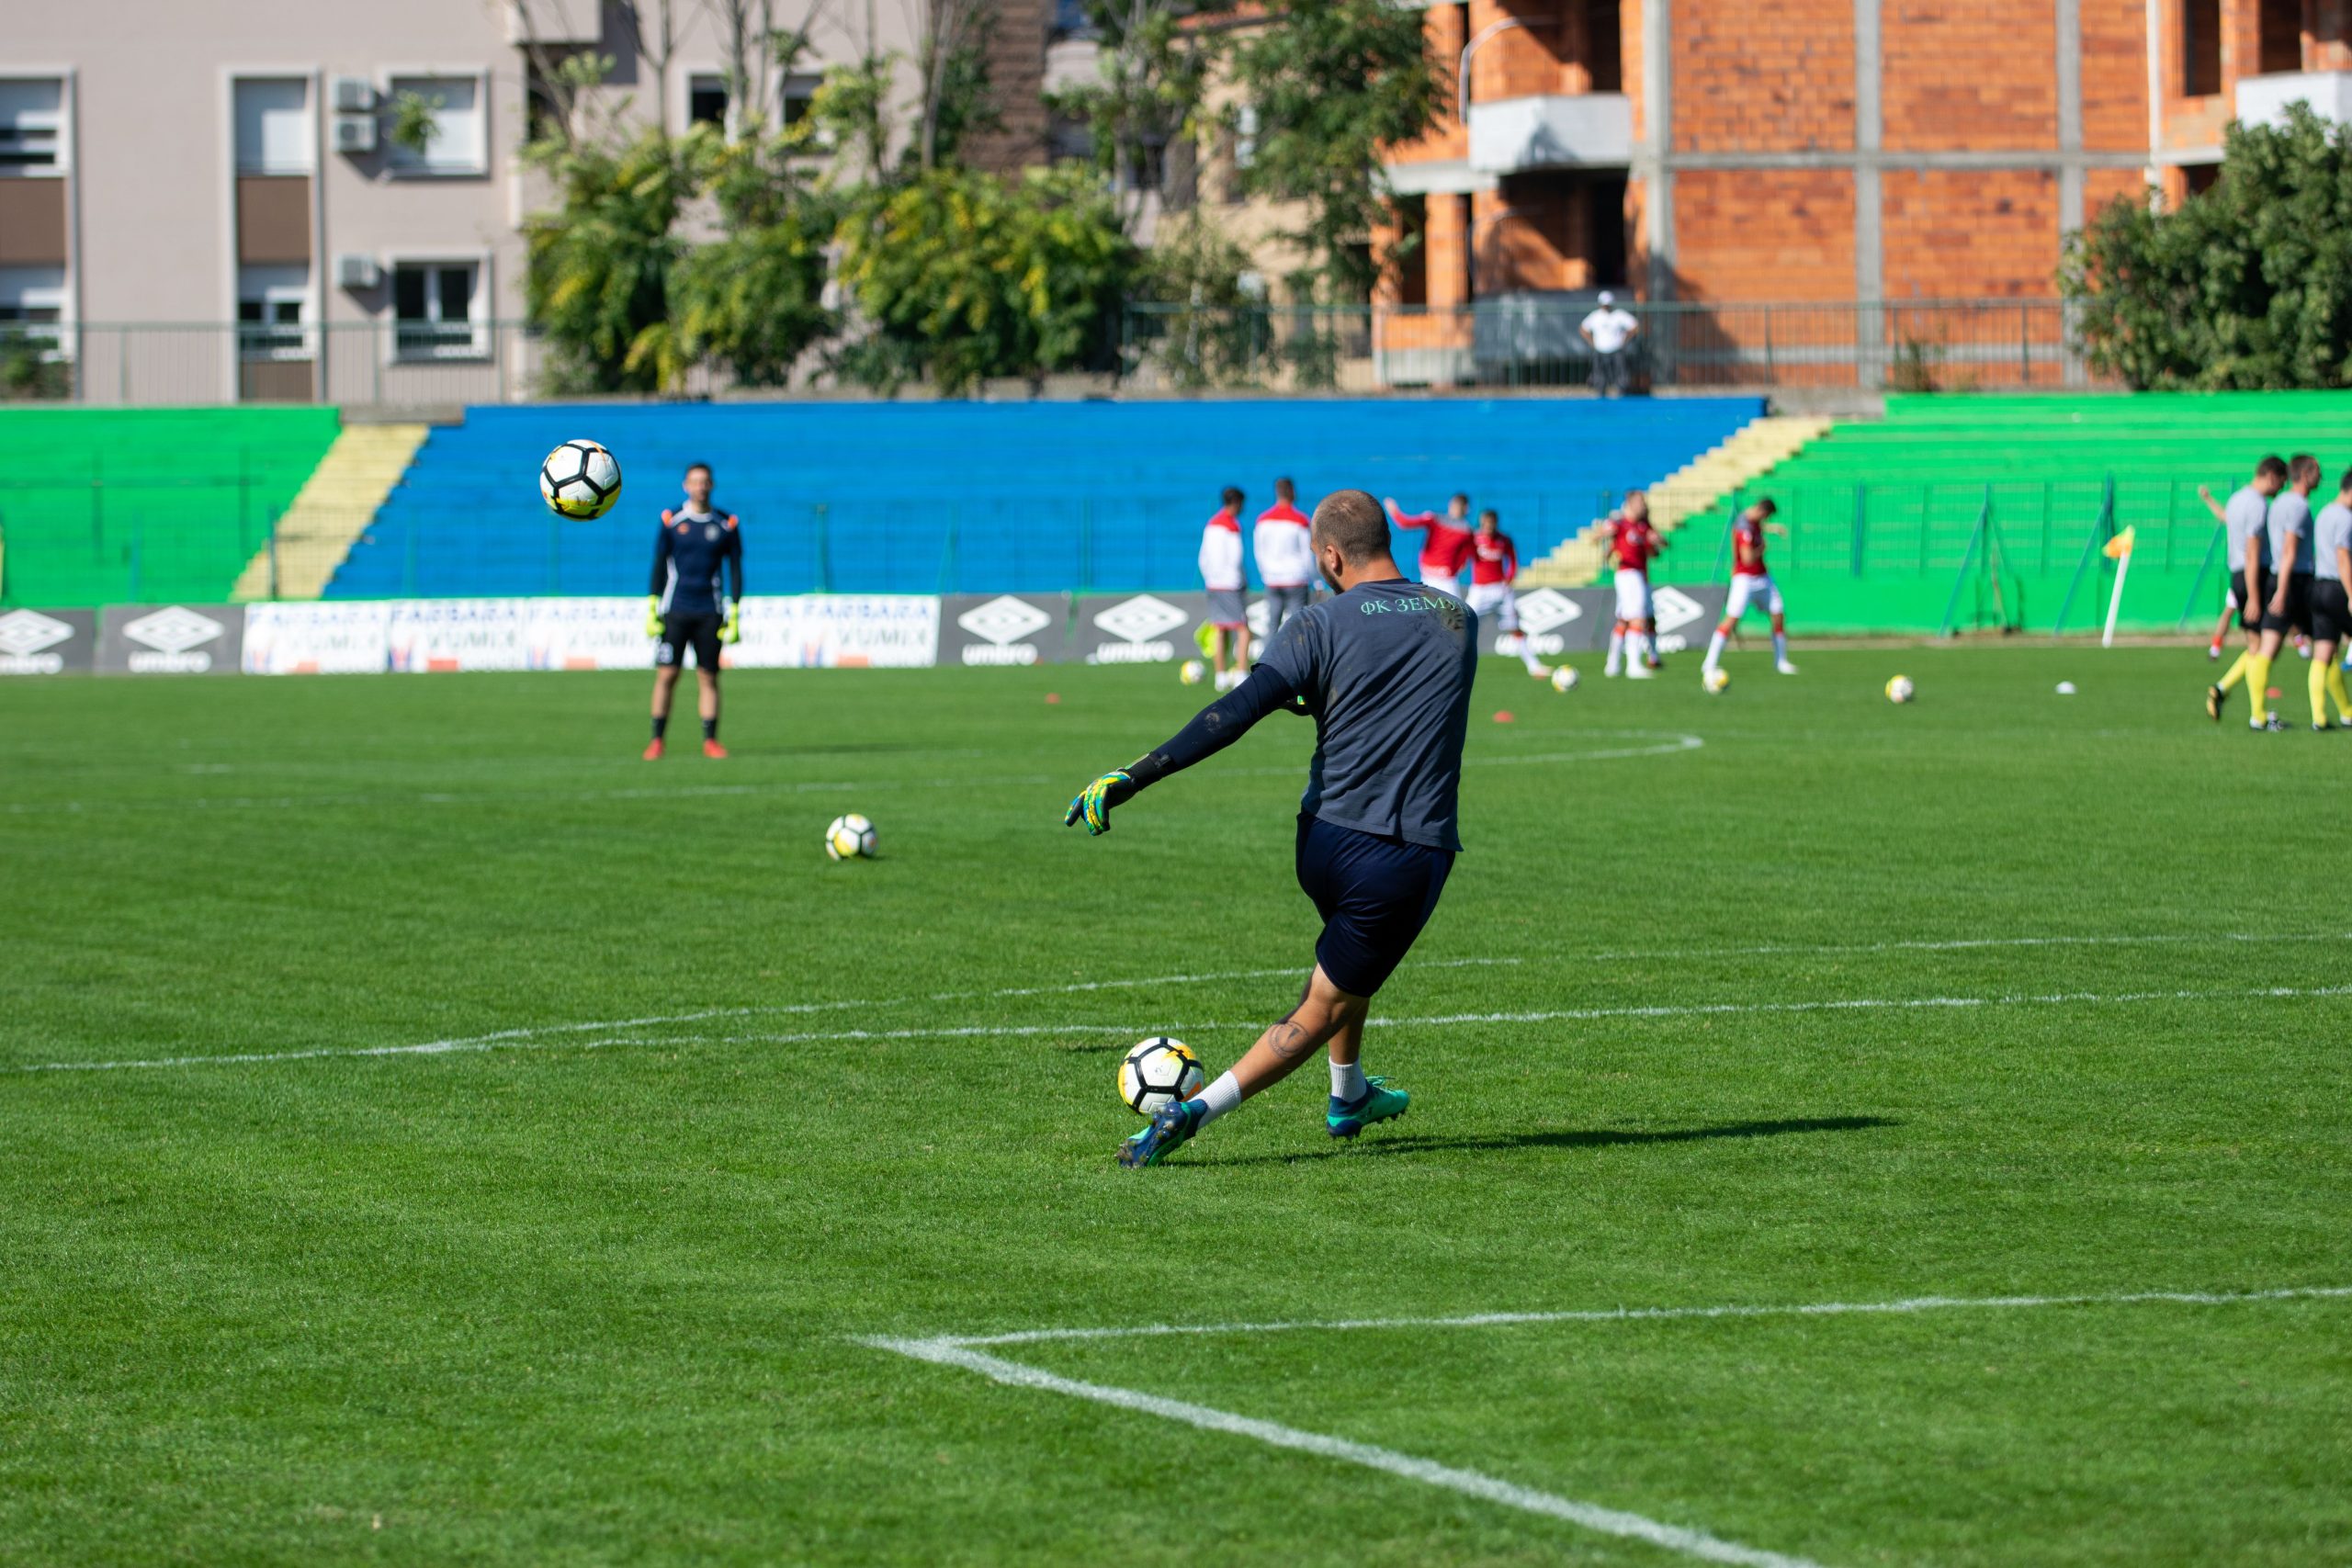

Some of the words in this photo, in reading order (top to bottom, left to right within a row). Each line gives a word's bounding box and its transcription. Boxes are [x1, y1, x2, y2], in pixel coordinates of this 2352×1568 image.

[1360, 600, 1392, 615] ФК
[128, 650, 212, 673] umbro
[962, 642, 1038, 666] umbro
[1096, 640, 1175, 663] umbro
